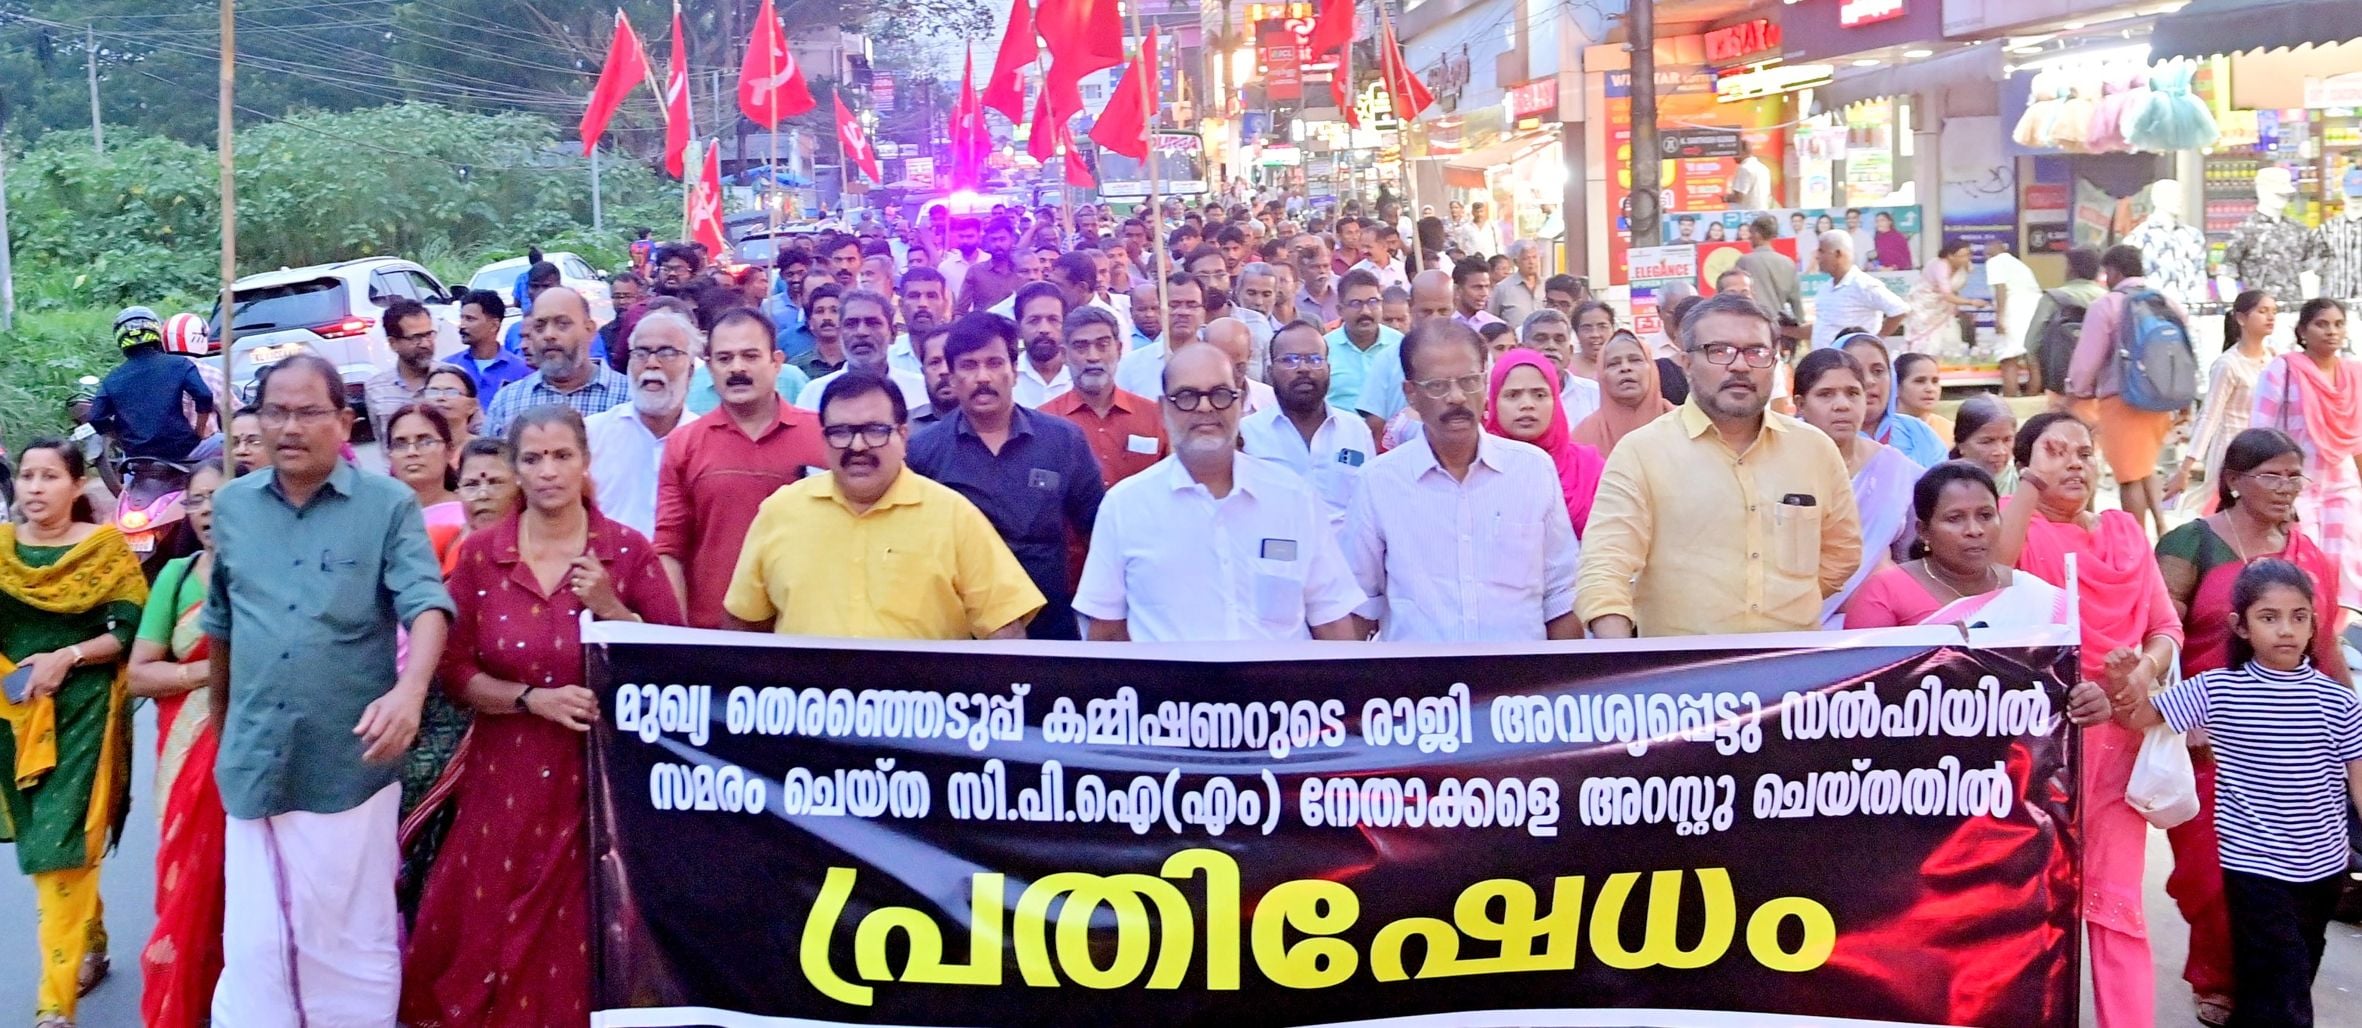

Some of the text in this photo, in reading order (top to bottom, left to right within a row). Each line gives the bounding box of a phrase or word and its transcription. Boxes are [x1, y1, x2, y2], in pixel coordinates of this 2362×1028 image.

[1635, 263, 1690, 279] ELEGANCE
[615, 675, 2050, 759] മുഖ്യ തെരഞ്ഞെടുപ്പ് കമ്മീഷണറുടെ രാജി അവശ്യപ്പെട്ടു ഡൽഹിയിൽ
[650, 755, 2013, 837] സമരം ചെയ്ത സി.പി.ഐ(എം) നേതാക്കളെ അറസ്റ്റു ചെയ്തതിൽ
[799, 848, 1837, 1007] പ്രതിഷേധം
